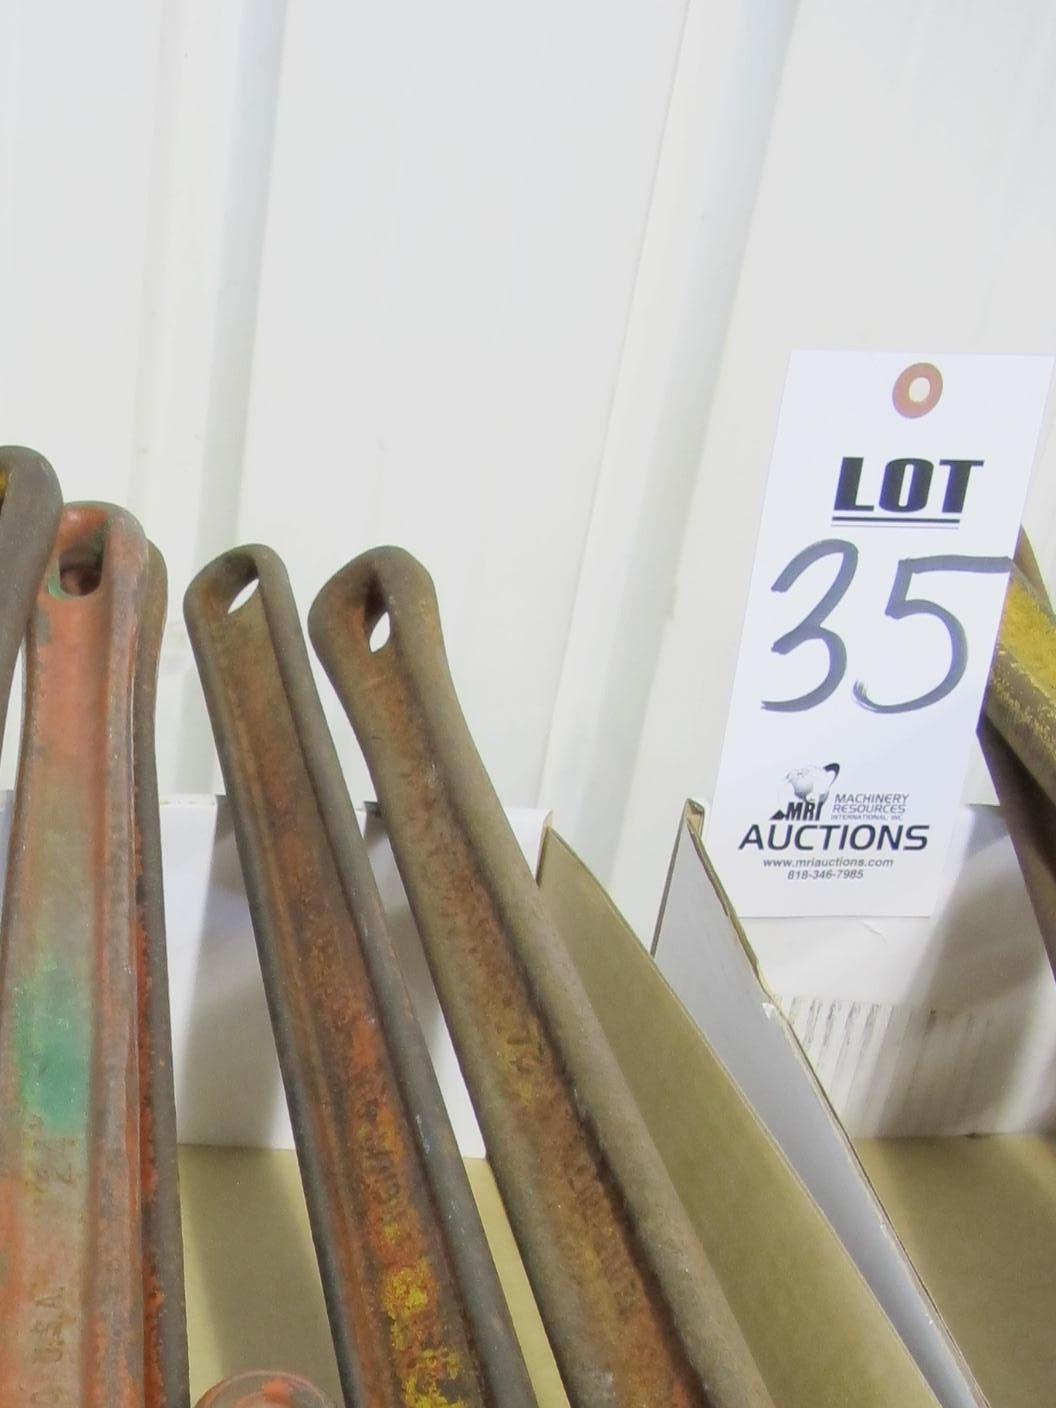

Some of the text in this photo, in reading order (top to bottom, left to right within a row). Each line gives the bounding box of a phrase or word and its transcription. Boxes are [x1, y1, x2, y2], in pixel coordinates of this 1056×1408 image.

[833, 456, 985, 514] LOT
[760, 538, 1012, 714] 35
[833, 793, 909, 804] MACHINERY
[786, 802, 824, 821] MRI
[832, 804, 906, 814] RESOURCES
[738, 824, 930, 851] AUCTIONS
[763, 857, 893, 868] www.mriauctions.com
[787, 869, 863, 880] 818-346-7985
